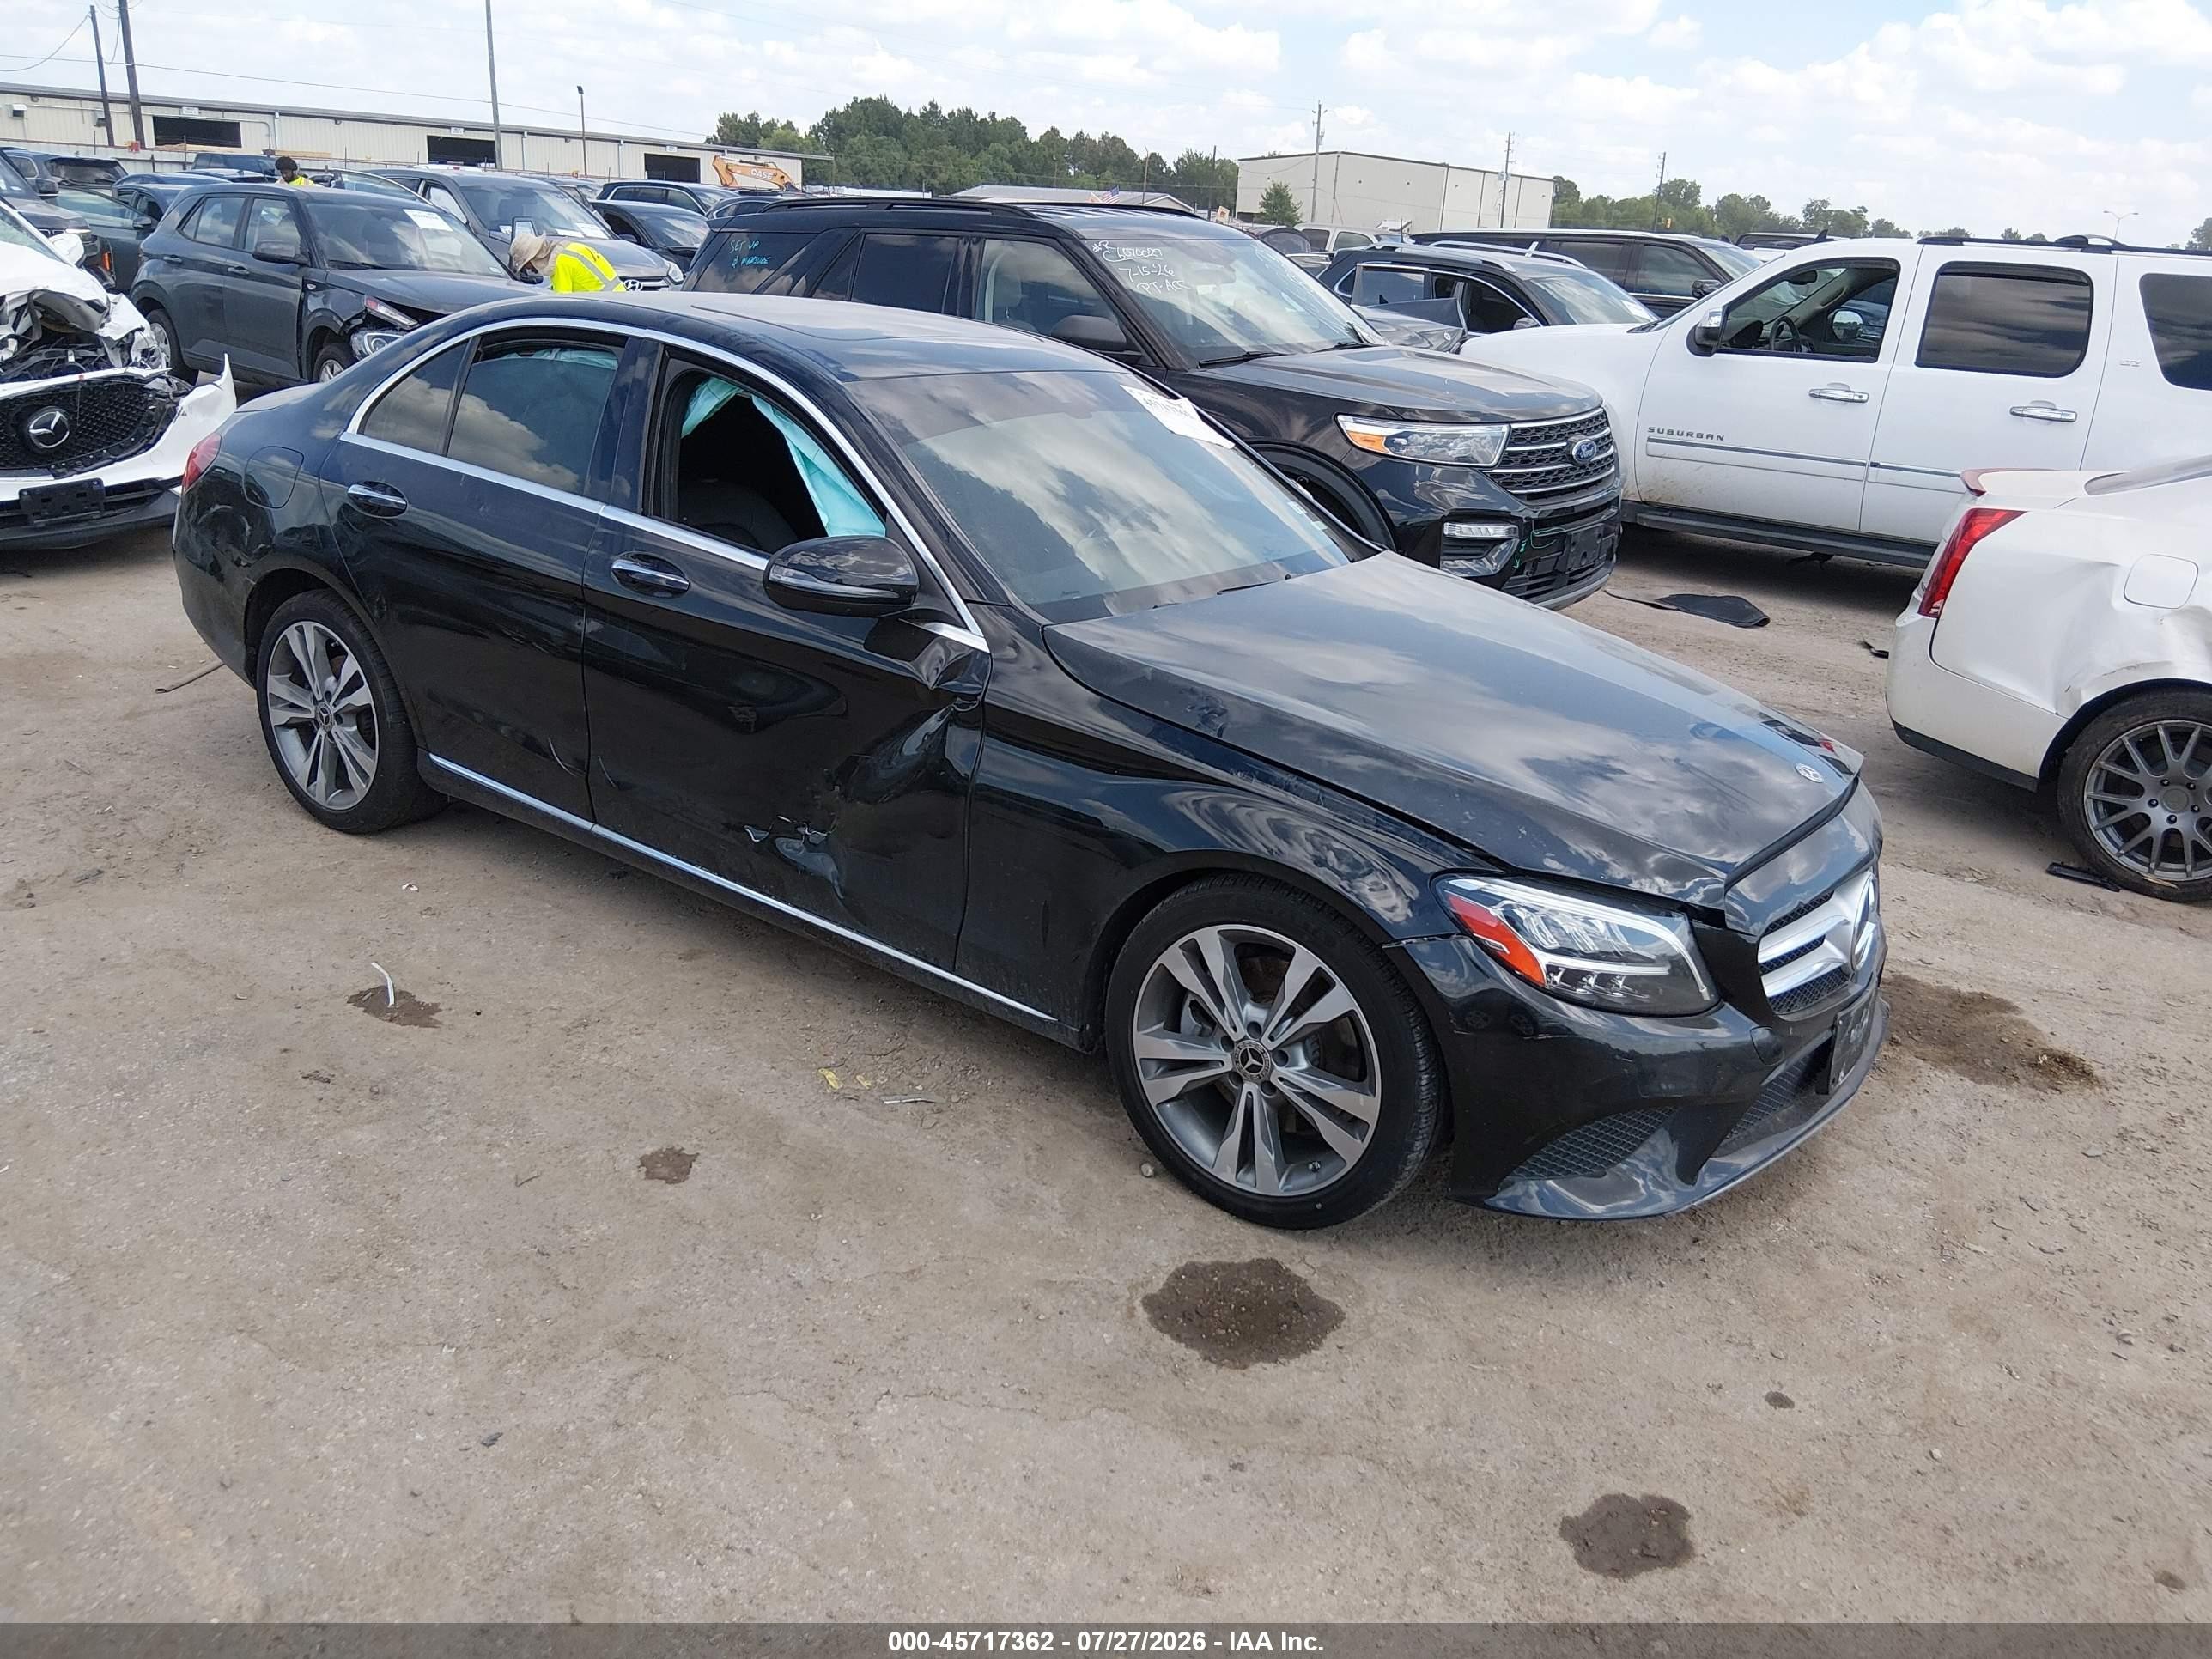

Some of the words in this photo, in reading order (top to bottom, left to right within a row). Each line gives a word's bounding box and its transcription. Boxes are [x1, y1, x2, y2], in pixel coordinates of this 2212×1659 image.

[750, 168, 773, 179] CASE
[748, 240, 760, 250] UP
[1118, 263, 1176, 283] 7-15-26
[1647, 427, 1724, 441] SUBURBAN
